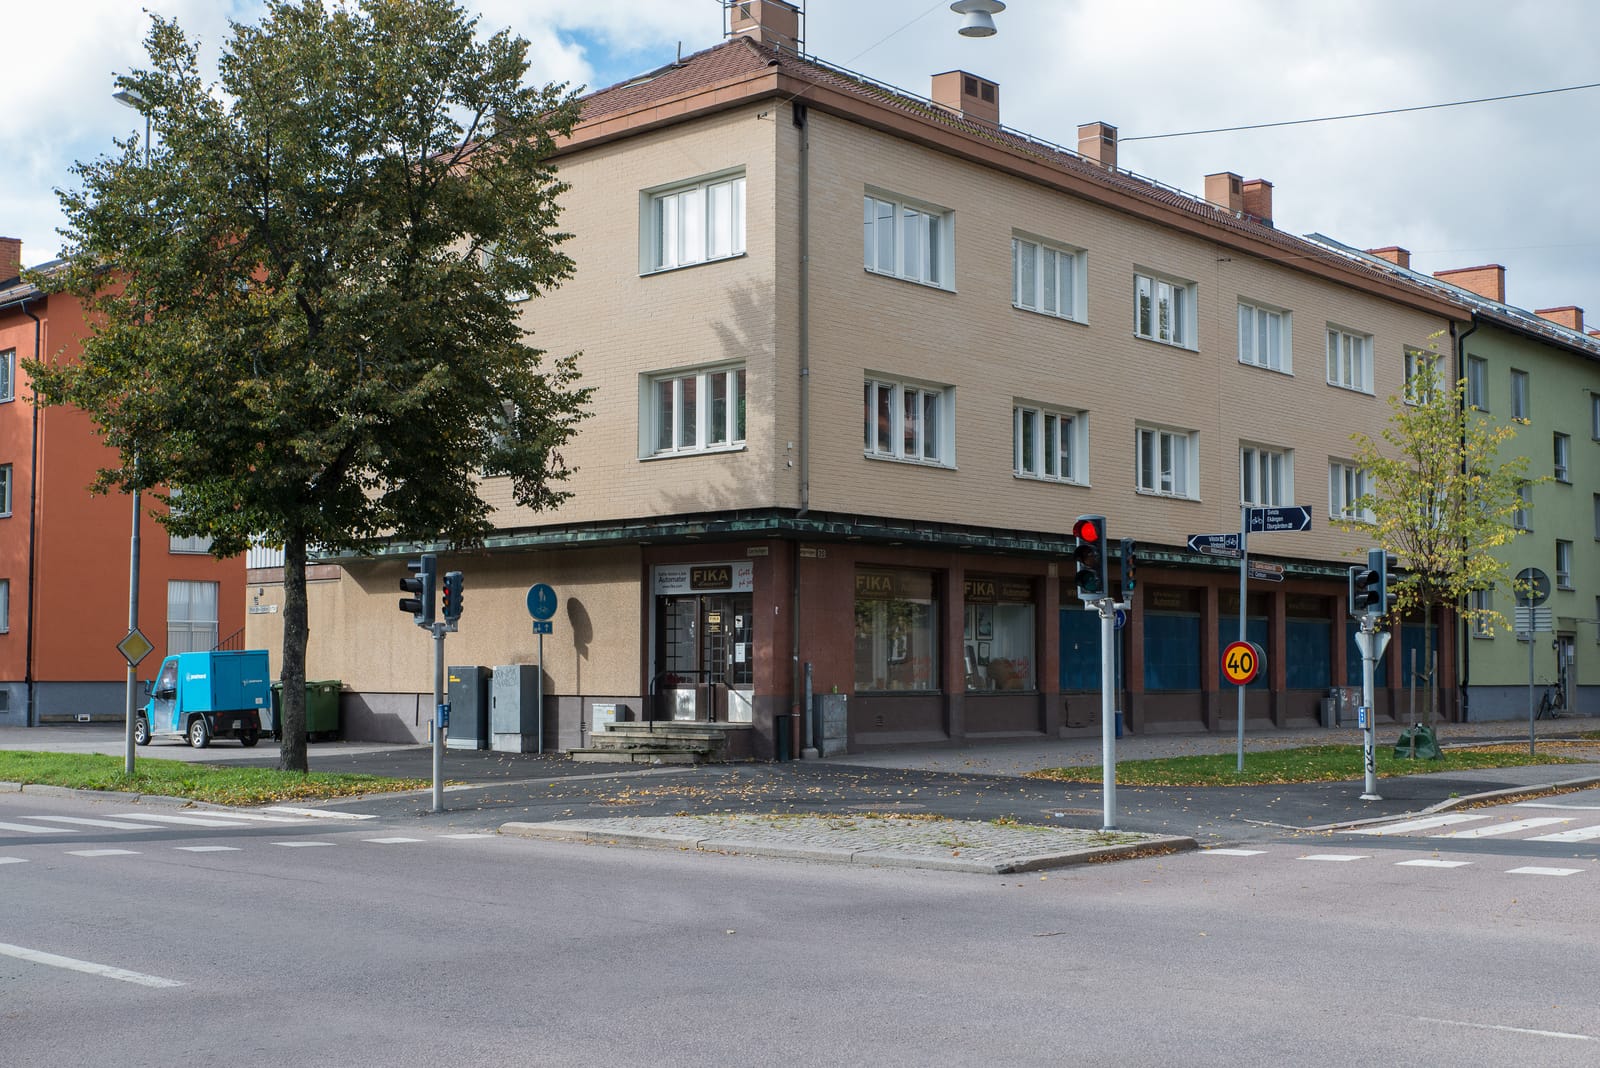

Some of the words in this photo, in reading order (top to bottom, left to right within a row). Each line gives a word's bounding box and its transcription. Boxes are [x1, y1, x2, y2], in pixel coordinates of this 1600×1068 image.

[693, 569, 729, 582] FIKA
[856, 576, 892, 590] FIKA
[963, 582, 995, 596] FIKA
[1227, 652, 1253, 674] 40
